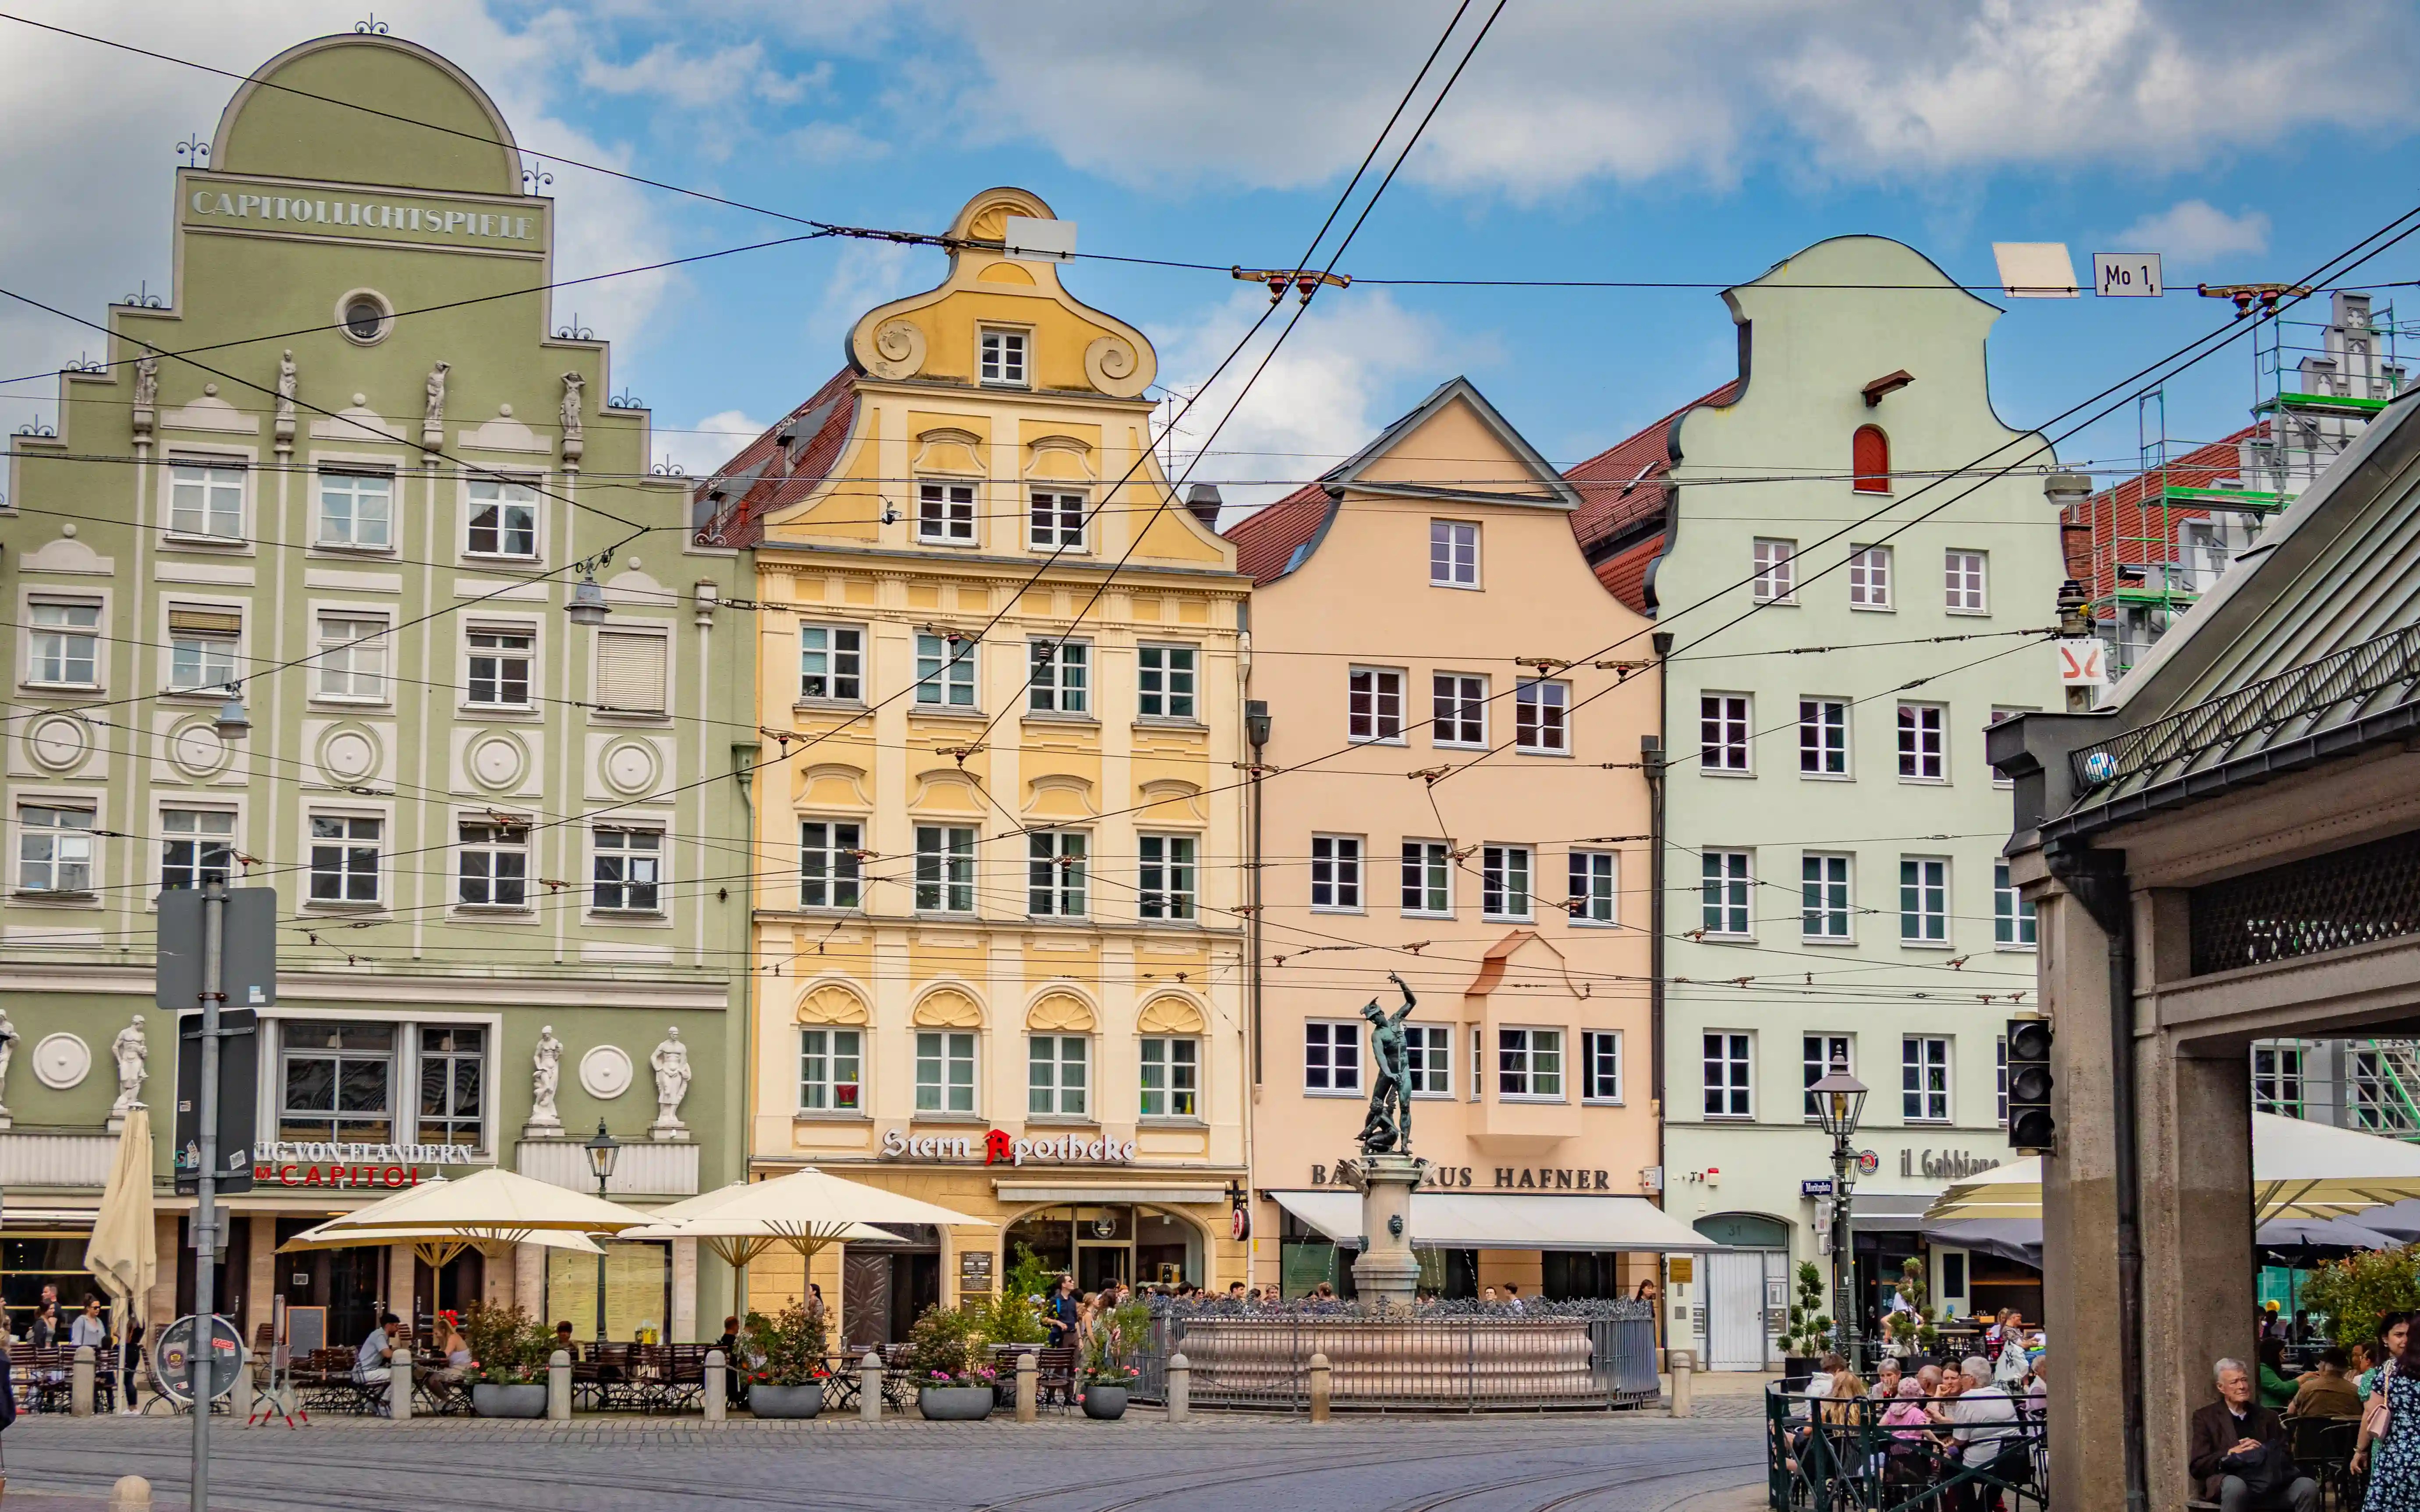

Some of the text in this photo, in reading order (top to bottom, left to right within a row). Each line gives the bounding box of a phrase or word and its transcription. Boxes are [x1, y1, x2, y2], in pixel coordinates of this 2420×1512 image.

[2106, 265, 2148, 285] Mo 1
[294, 1142, 344, 1162] VON
[349, 1143, 473, 1164] FLANDERN
[879, 1127, 1138, 1167] Stern Apotheke
[1900, 1149, 1912, 1178] il
[280, 1164, 419, 1188] CAPITOL
[1494, 1167, 1610, 1190] HAFNER
[1805, 1182, 1831, 1194] Moritzplatz
[1728, 1224, 1741, 1236] 31
